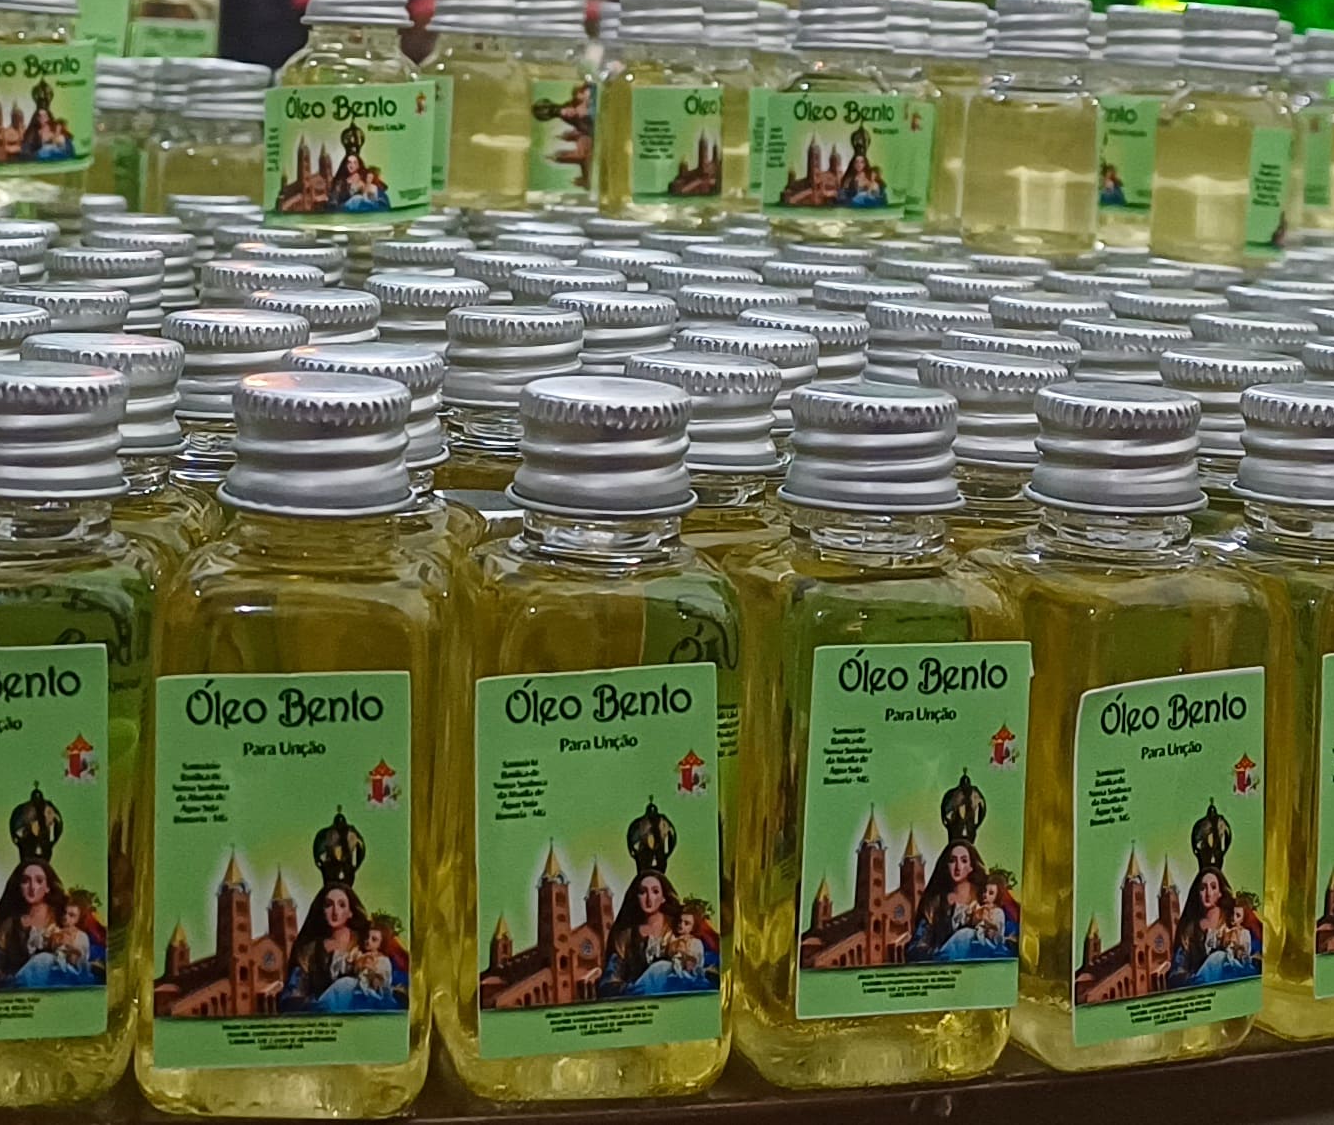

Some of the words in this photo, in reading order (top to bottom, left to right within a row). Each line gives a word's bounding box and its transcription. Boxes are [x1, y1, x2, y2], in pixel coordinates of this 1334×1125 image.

[24, 55, 80, 78] Bento
[285, 89, 326, 121] Óleo
[332, 95, 397, 121] Bento
[794, 94, 837, 123] Óleo
[843, 100, 895, 123] Bento
[838, 649, 908, 695] Óleo
[917, 657, 1008, 695] Bento
[186, 679, 267, 729] Óleo
[278, 687, 384, 727] Bento
[505, 679, 582, 726] Óleo
[592, 683, 692, 722] Bento
[885, 707, 914, 722] Para
[916, 706, 957, 724] Unção
[1101, 692, 1160, 736] Óleo
[1168, 692, 1247, 731] Bento
[243, 742, 276, 756] Para
[279, 741, 326, 758] Unção
[559, 737, 591, 753] Para
[594, 734, 638, 752] Unção
[1141, 746, 1165, 760] Para
[1167, 741, 1202, 758] Unção
